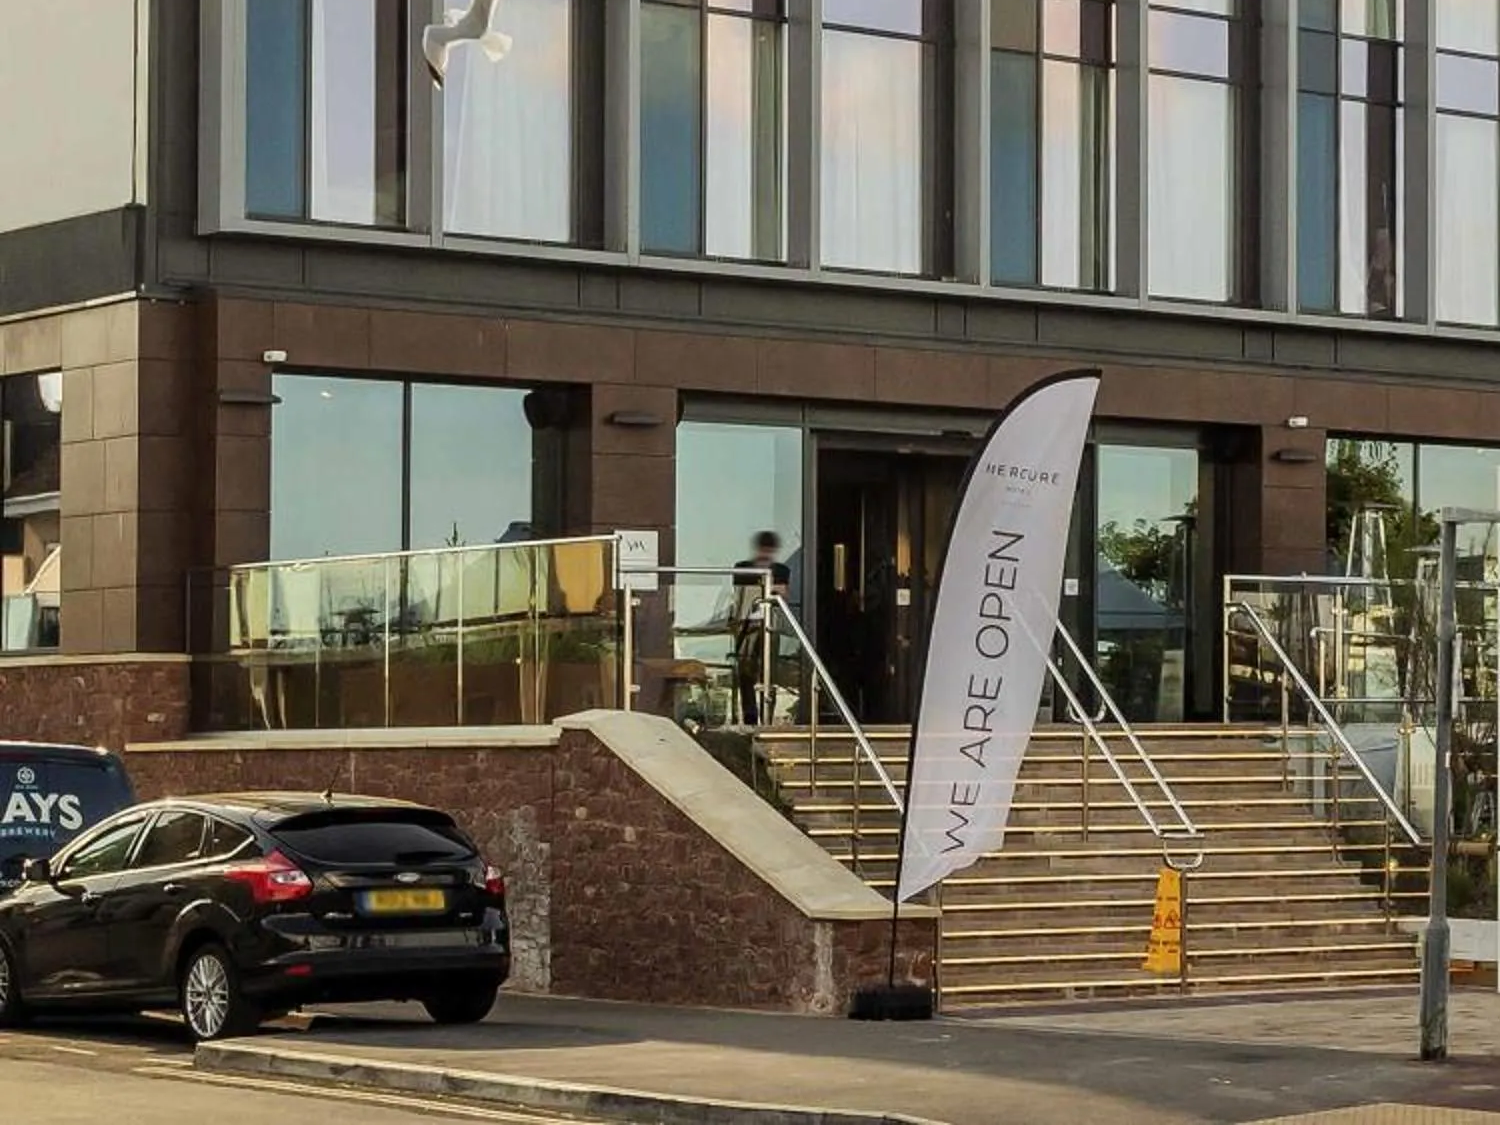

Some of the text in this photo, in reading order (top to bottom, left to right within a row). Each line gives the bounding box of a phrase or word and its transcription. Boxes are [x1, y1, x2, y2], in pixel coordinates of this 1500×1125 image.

[985, 461, 1062, 485] MERCURE
[975, 529, 1025, 659] OPEN
[959, 674, 1003, 766] ARE
[1, 791, 83, 830] AYS
[940, 781, 982, 854] WE
